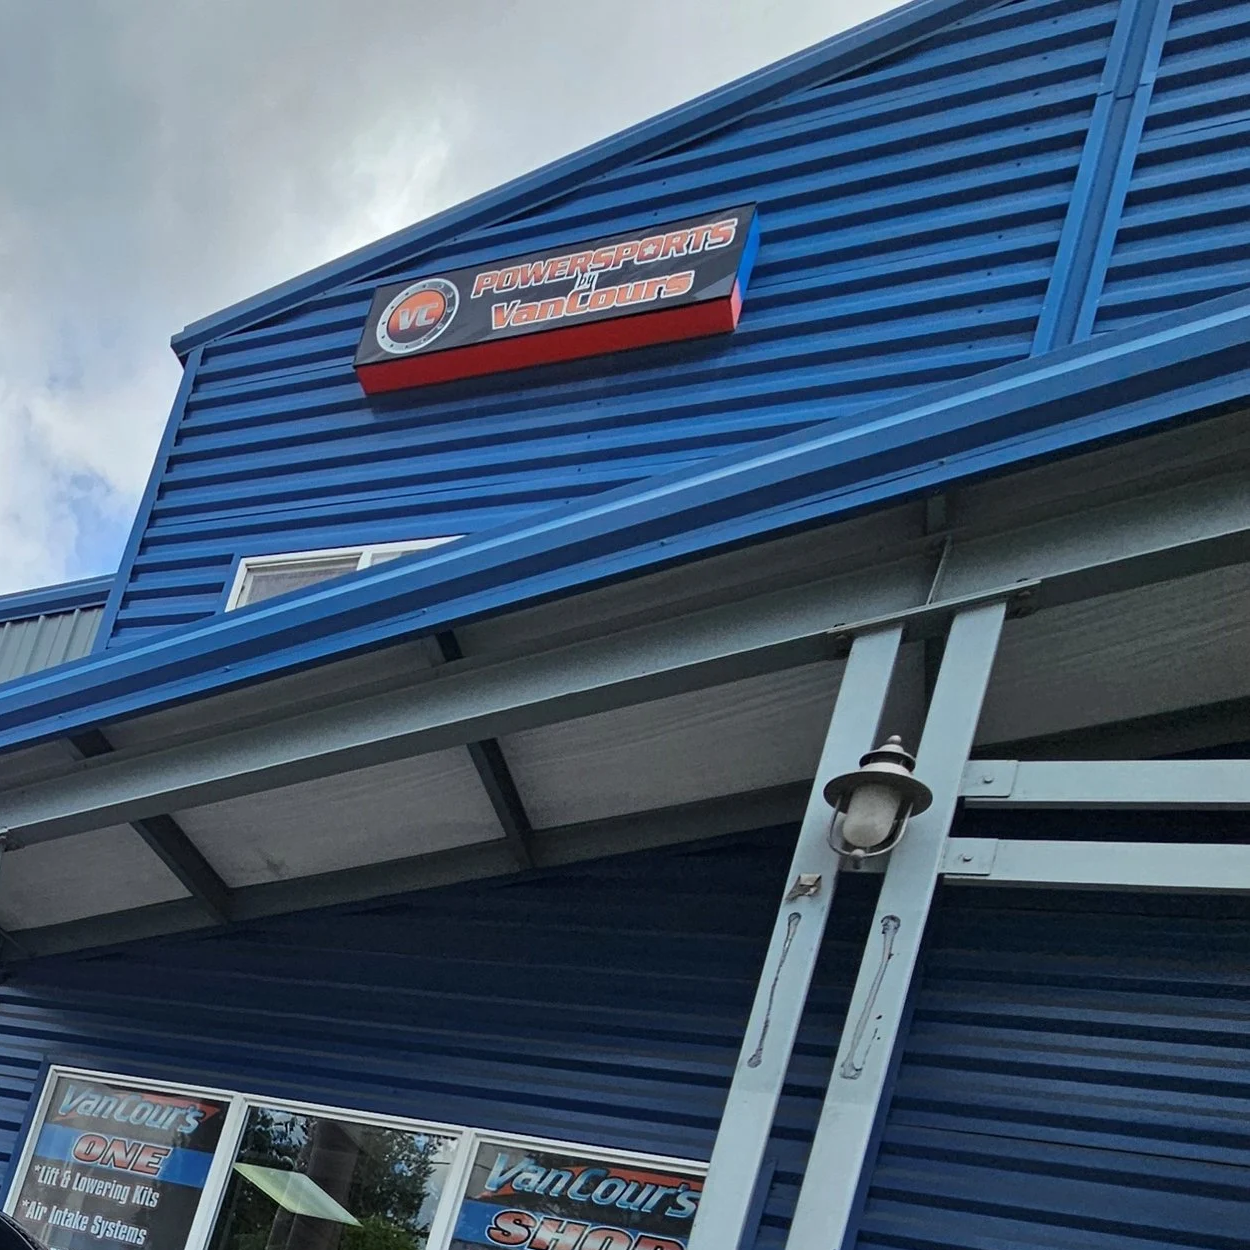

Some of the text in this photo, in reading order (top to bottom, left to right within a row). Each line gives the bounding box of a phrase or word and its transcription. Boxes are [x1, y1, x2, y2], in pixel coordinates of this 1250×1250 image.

[470, 218, 738, 299] POWERSPORTS
[398, 301, 440, 330] VC
[490, 271, 696, 330] VanCours
[57, 1084, 204, 1135] VanCour's
[72, 1132, 173, 1177] ONE
[60, 1169, 72, 1189] &
[72, 1172, 131, 1205] Lowering
[131, 1184, 160, 1208] Kits
[484, 1153, 701, 1219] VanCour's
[48, 1205, 89, 1231] Intake
[90, 1214, 148, 1246] Systems
